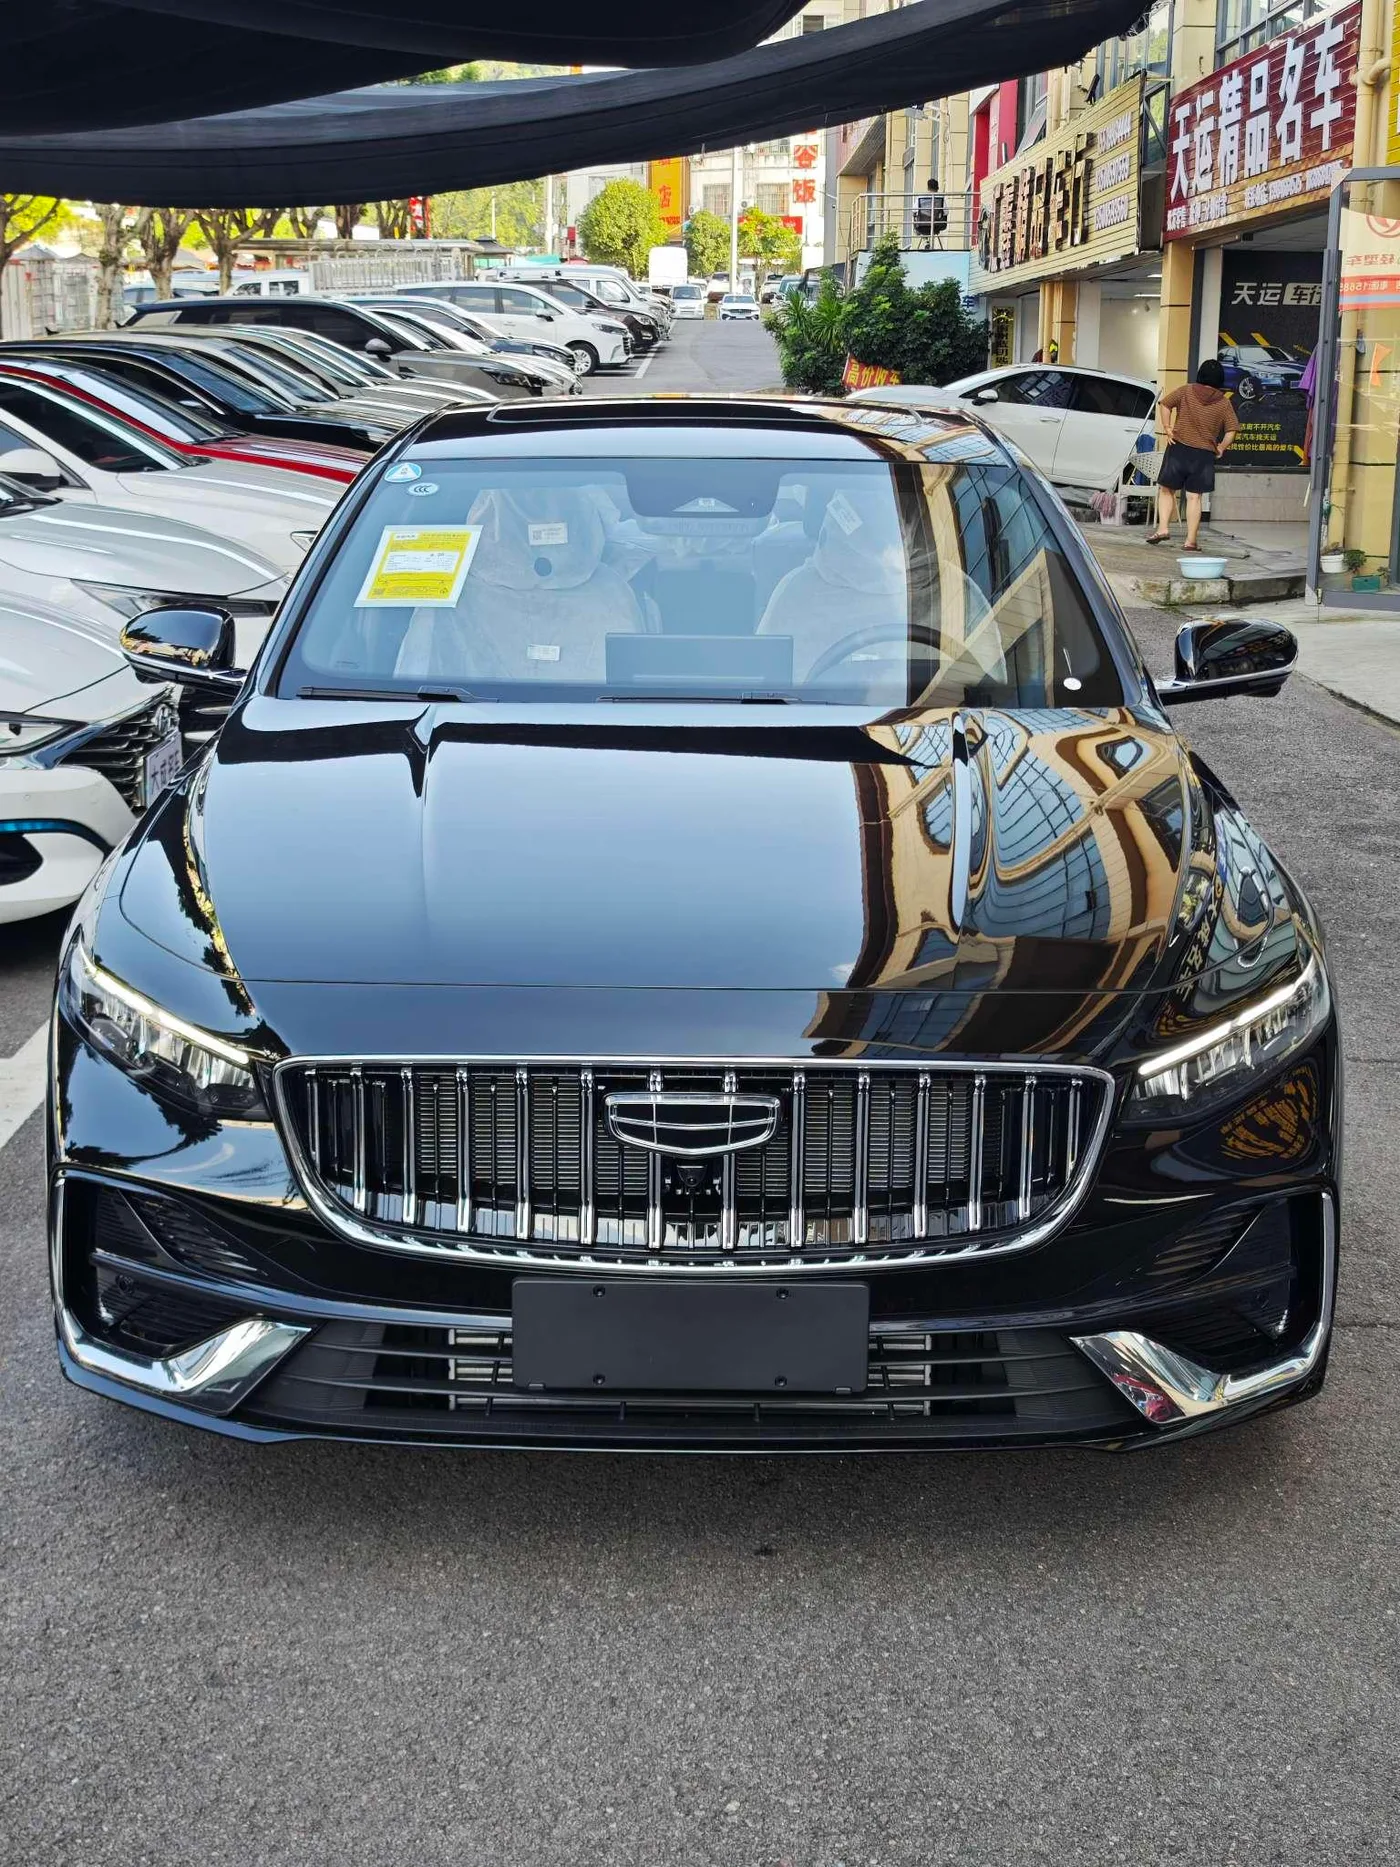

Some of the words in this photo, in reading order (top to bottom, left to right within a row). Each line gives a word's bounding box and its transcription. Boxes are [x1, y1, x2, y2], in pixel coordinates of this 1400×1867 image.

[1170, 17, 1344, 203] 天运精品名车
